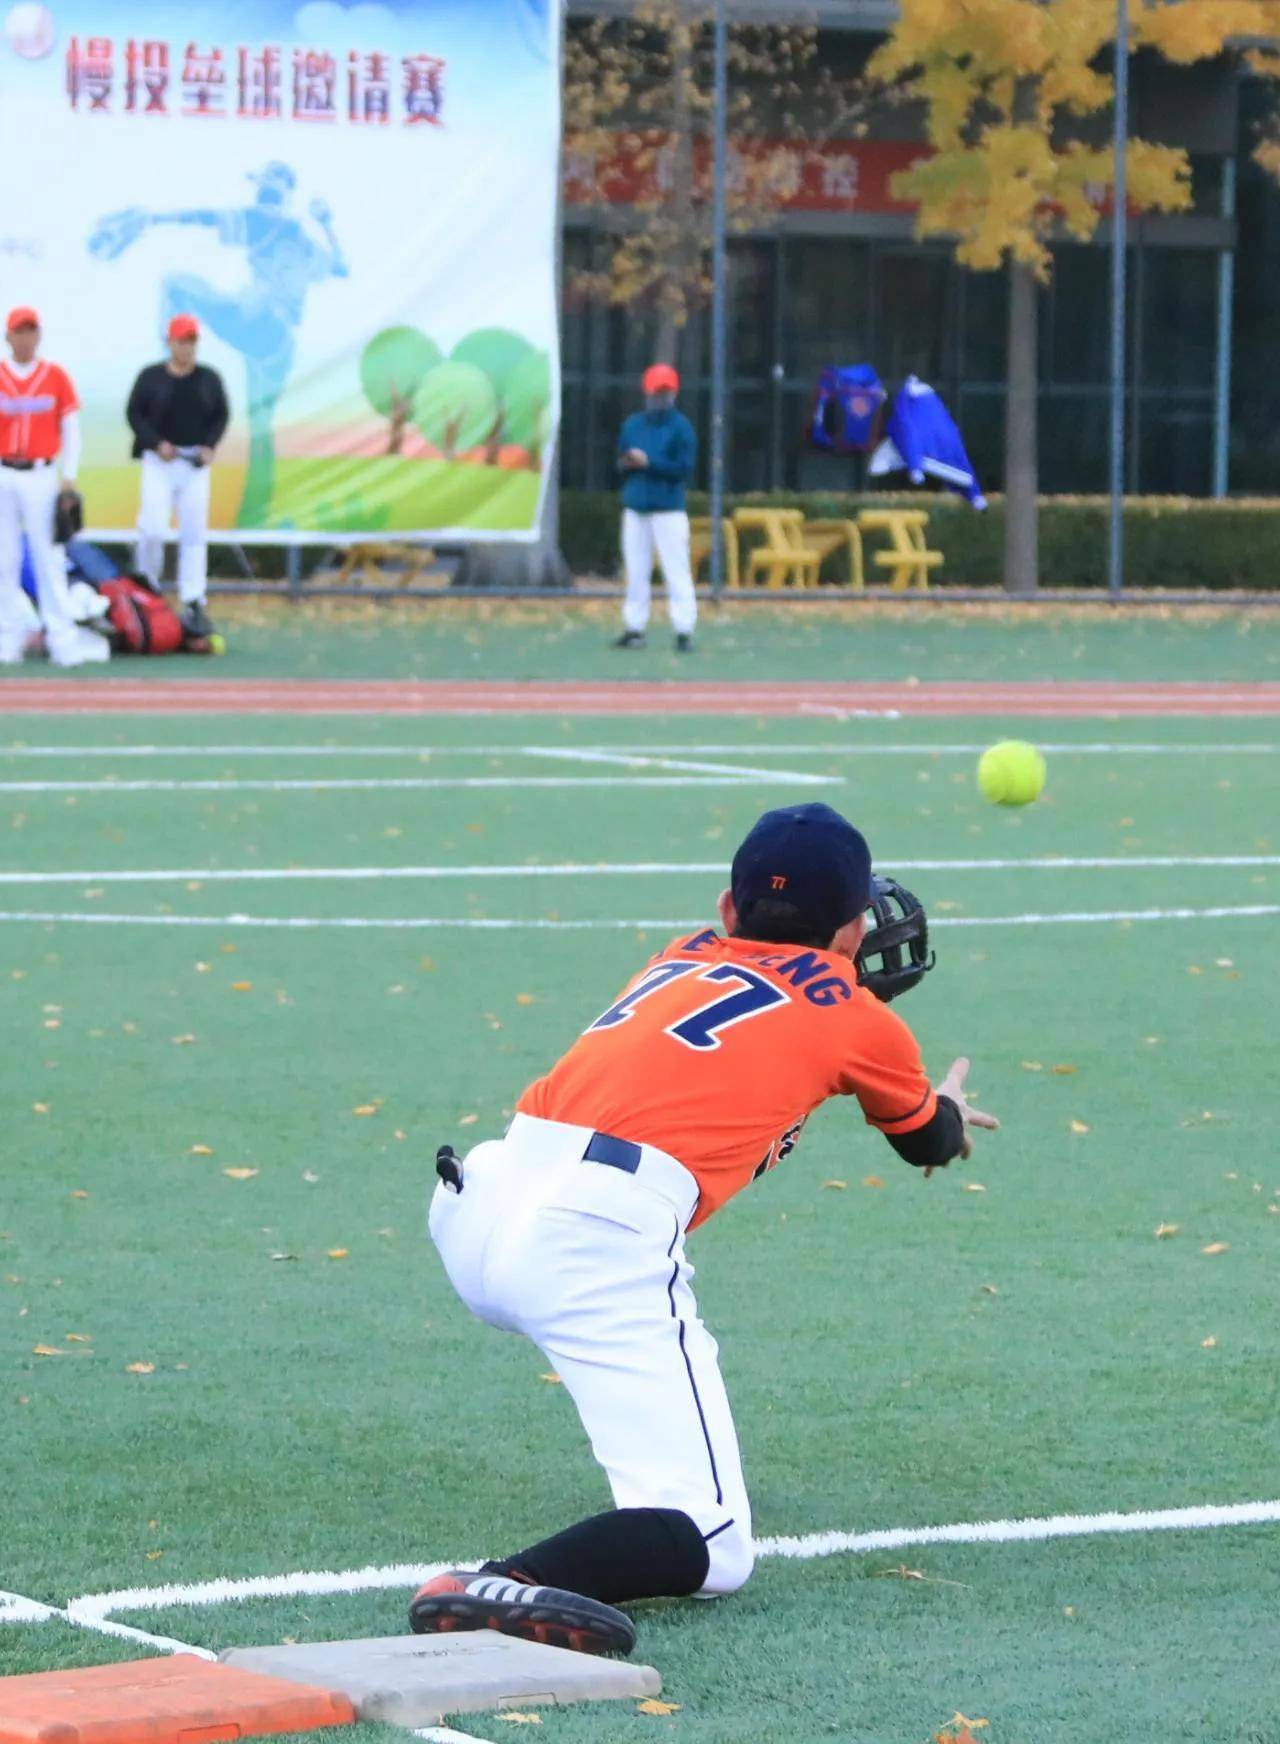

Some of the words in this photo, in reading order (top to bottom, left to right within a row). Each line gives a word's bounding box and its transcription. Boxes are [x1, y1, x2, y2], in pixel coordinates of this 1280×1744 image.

[65, 35, 447, 127] 慢投垒球邀请赛
[582, 960, 792, 1052] 77
